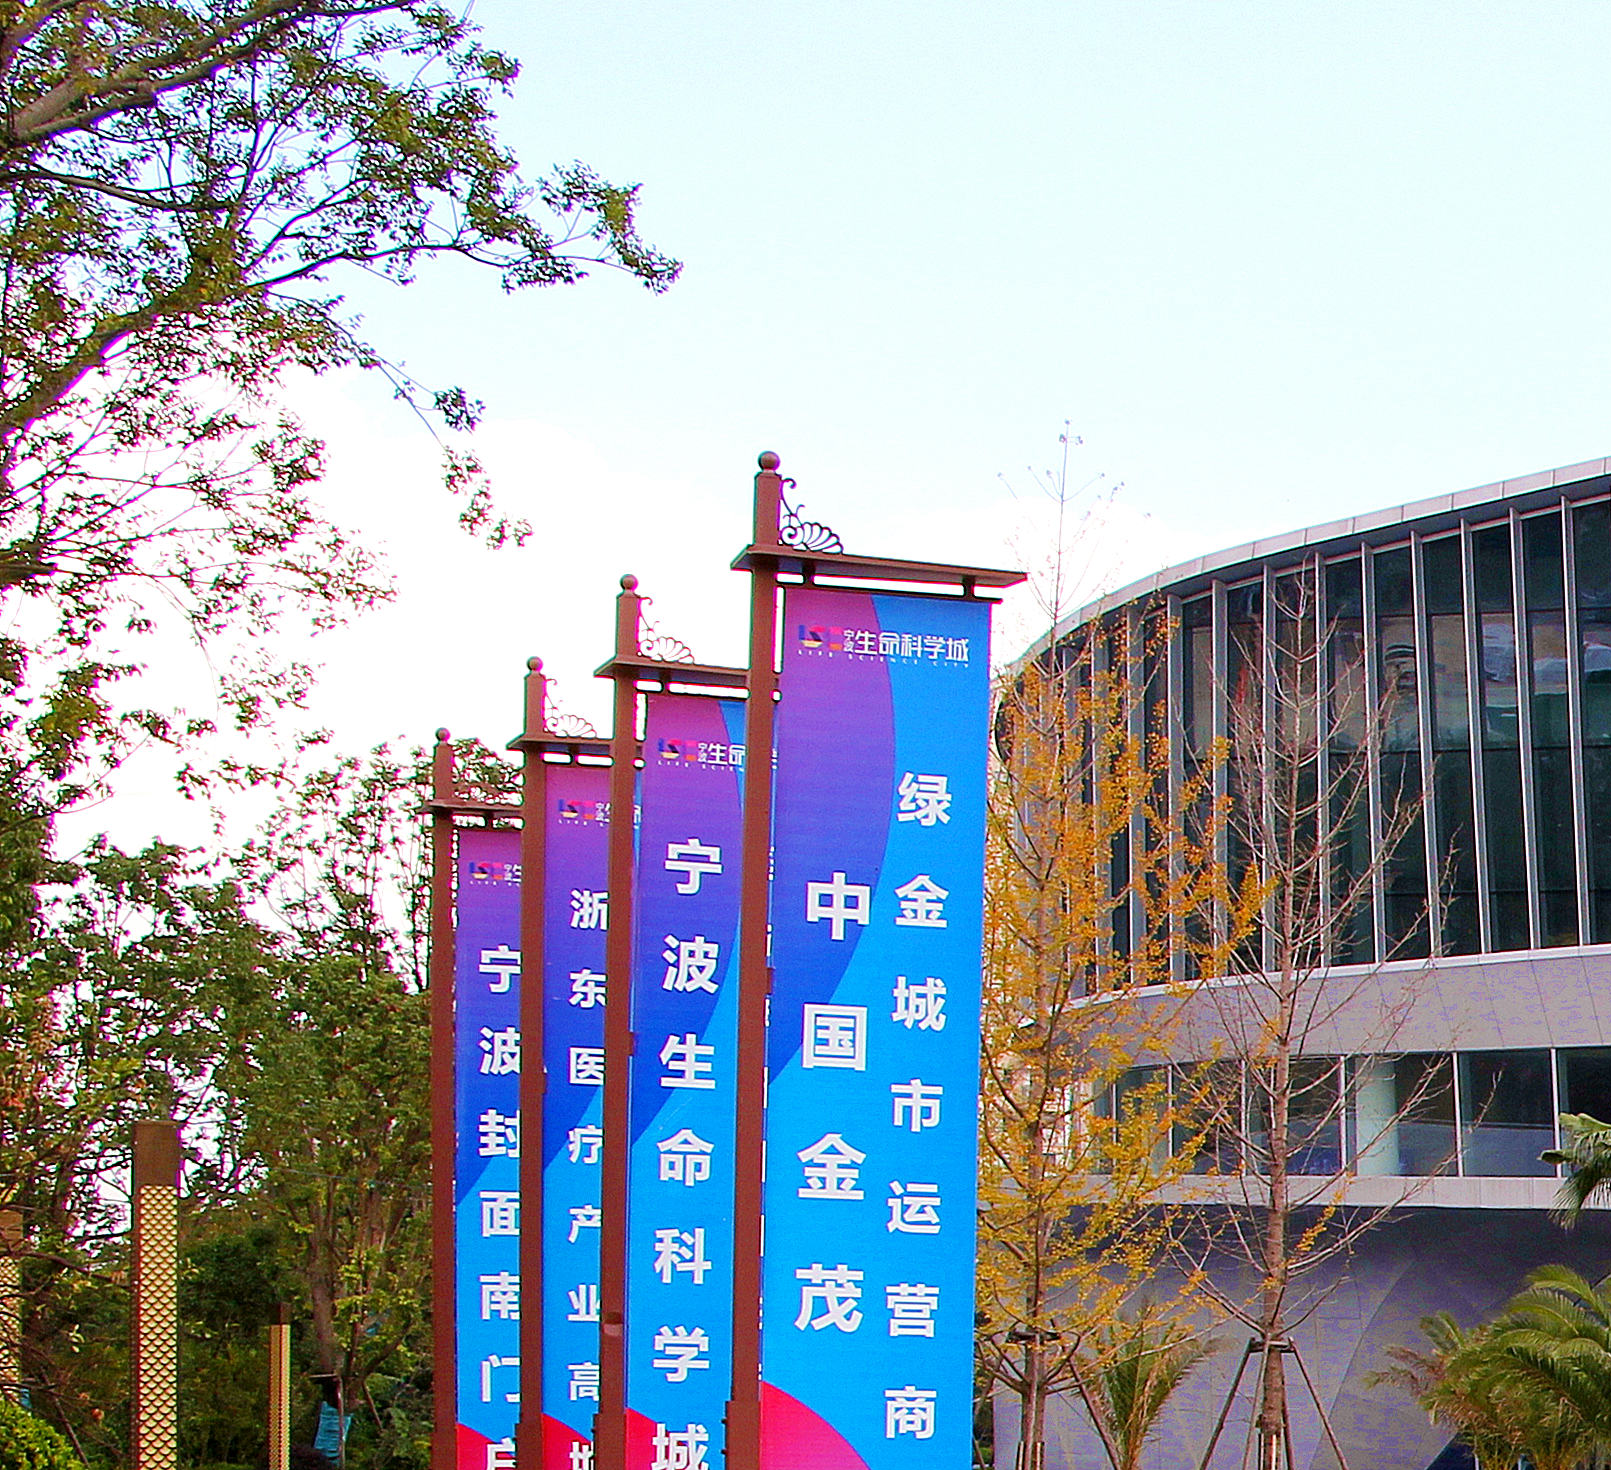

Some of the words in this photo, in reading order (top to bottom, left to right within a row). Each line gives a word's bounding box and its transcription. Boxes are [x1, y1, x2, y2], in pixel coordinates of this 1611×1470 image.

[854, 630, 969, 662] 生命科学城
[794, 872, 872, 1334] 中国金茂
[884, 772, 952, 1439] 绿金城市运营商
